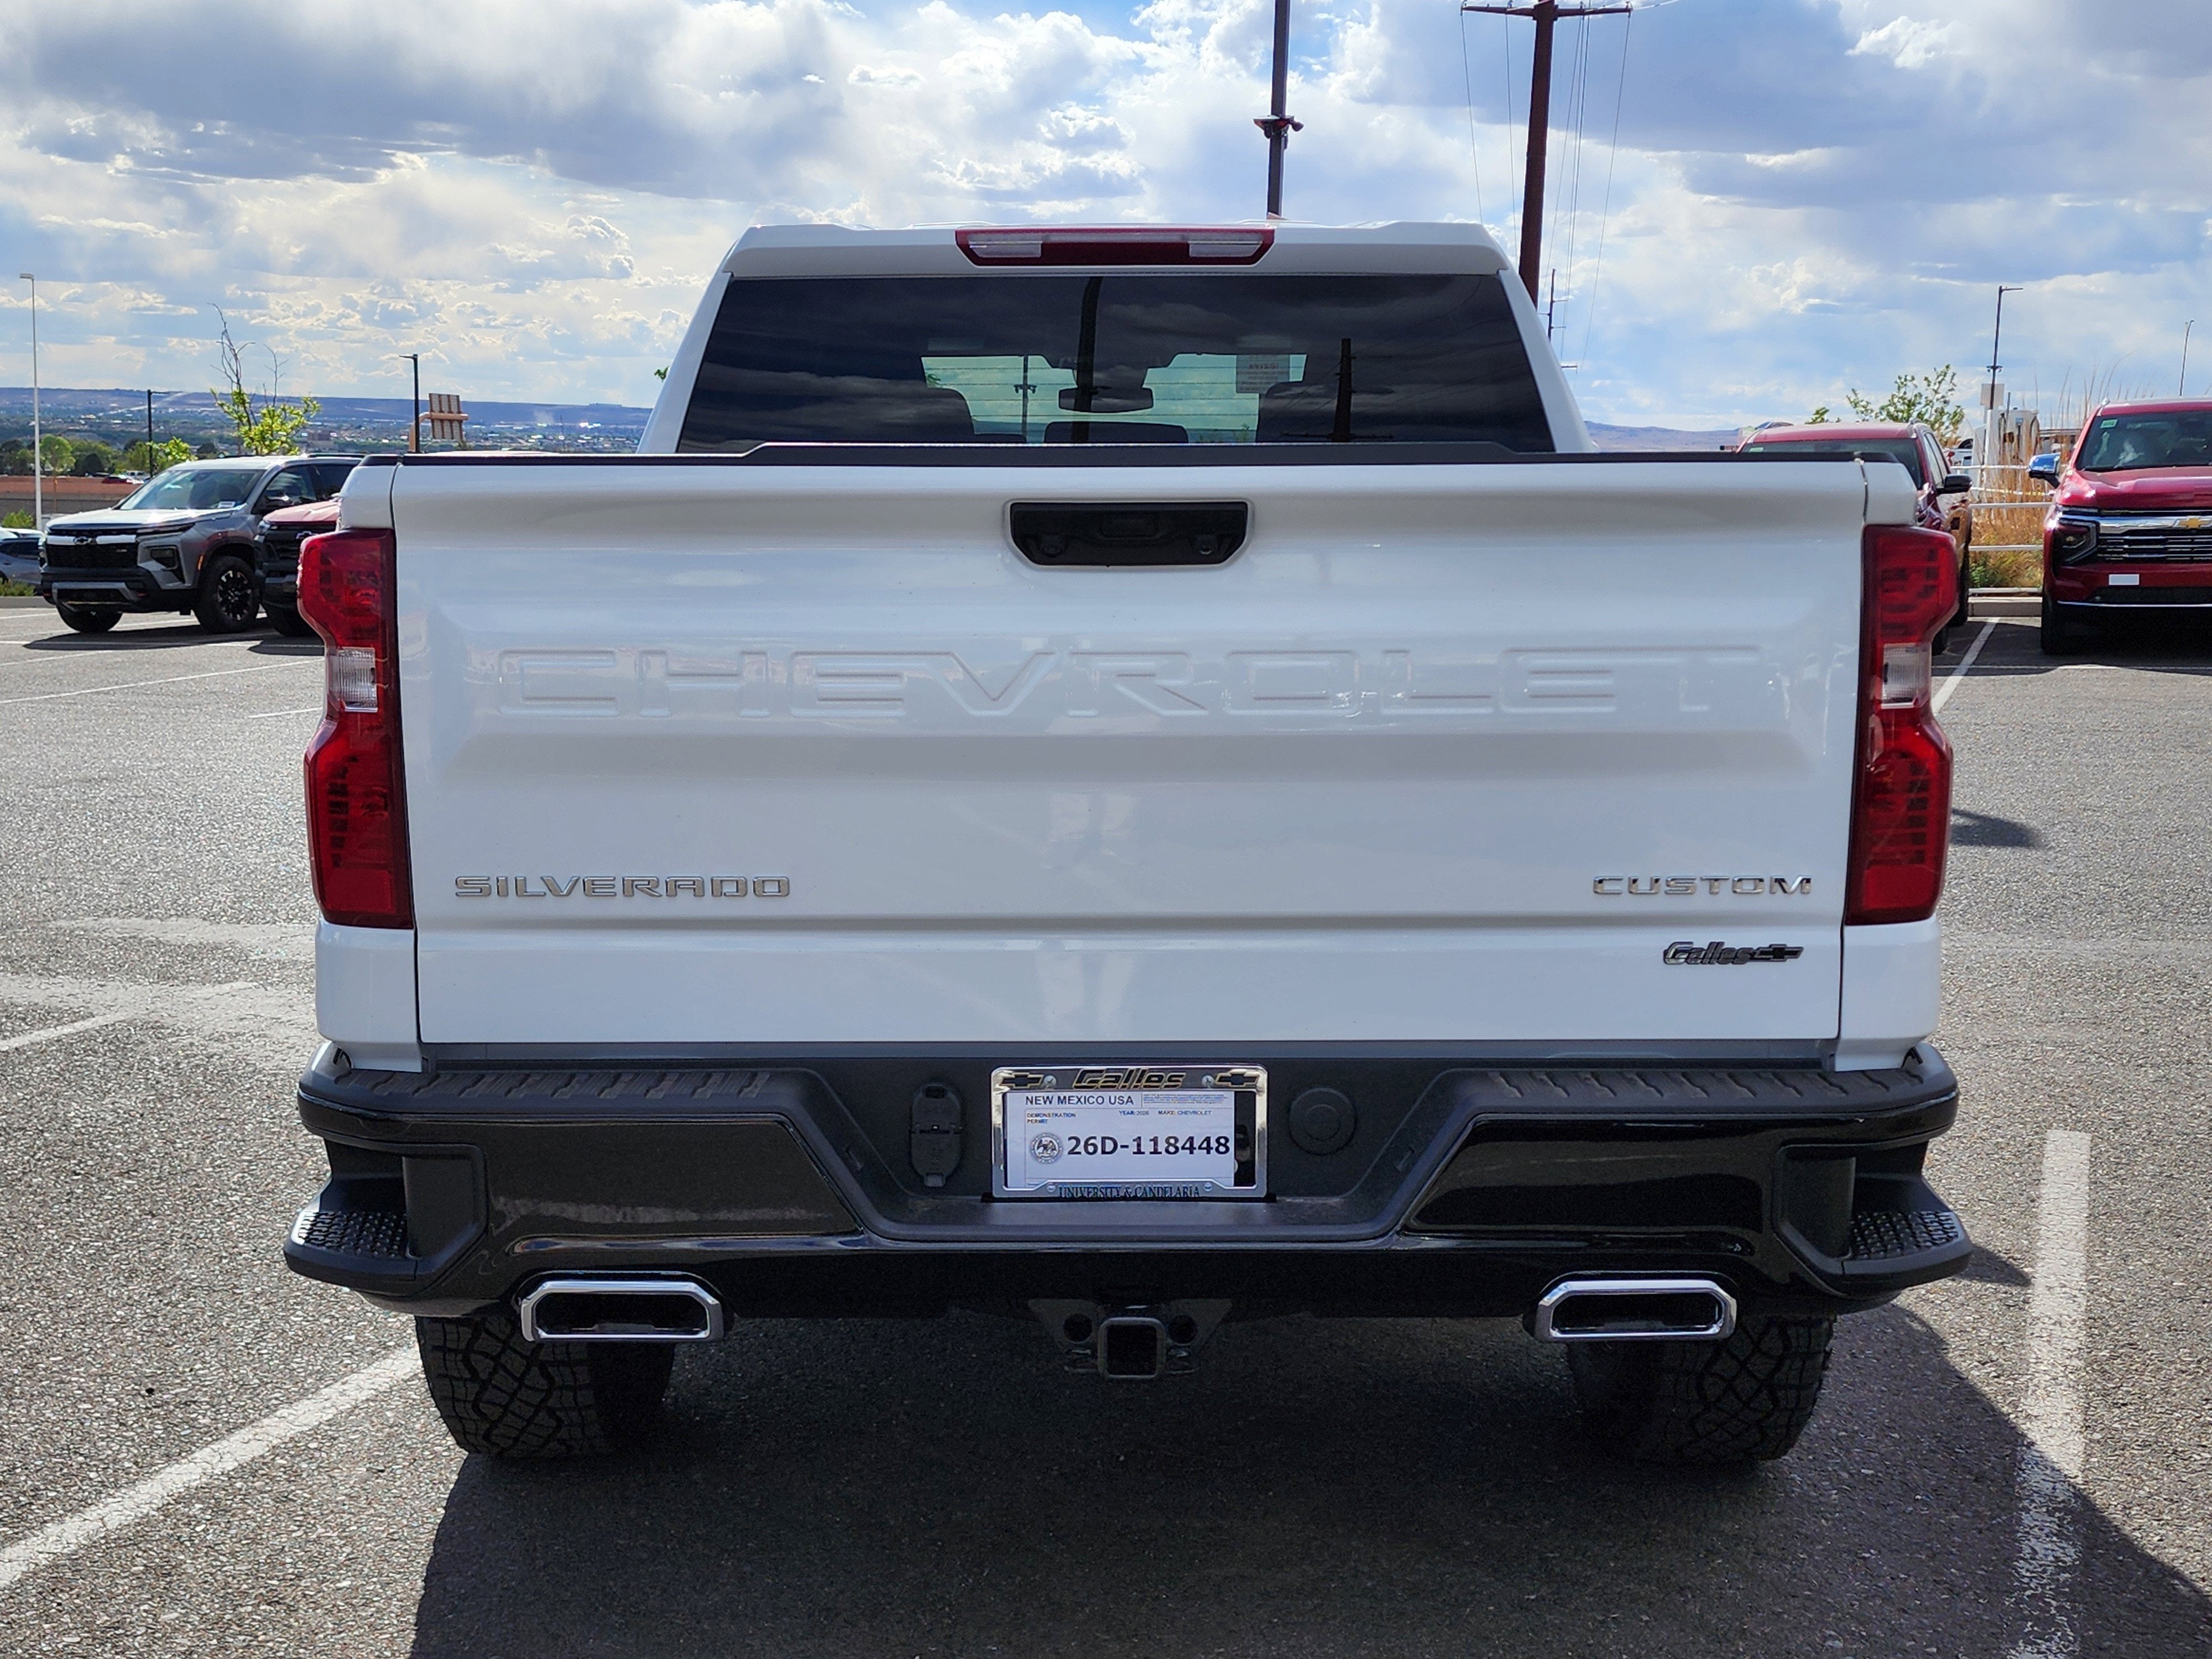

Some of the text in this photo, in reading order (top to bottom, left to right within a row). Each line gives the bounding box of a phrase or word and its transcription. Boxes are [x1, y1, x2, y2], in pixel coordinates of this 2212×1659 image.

[498, 647, 1761, 717] CHEVROLET
[455, 875, 790, 898] SILVERADO
[1593, 875, 1812, 895] CUSTOM
[1072, 1068, 1186, 1090] Galles
[1026, 1095, 1054, 1105] NEW
[1057, 1095, 1105, 1105] MEXICO
[1109, 1095, 1134, 1105] USA
[1067, 1135, 1230, 1155] 26D-118448
[1058, 1186, 1200, 1197] UNIVERSITY & CANDELARIA
